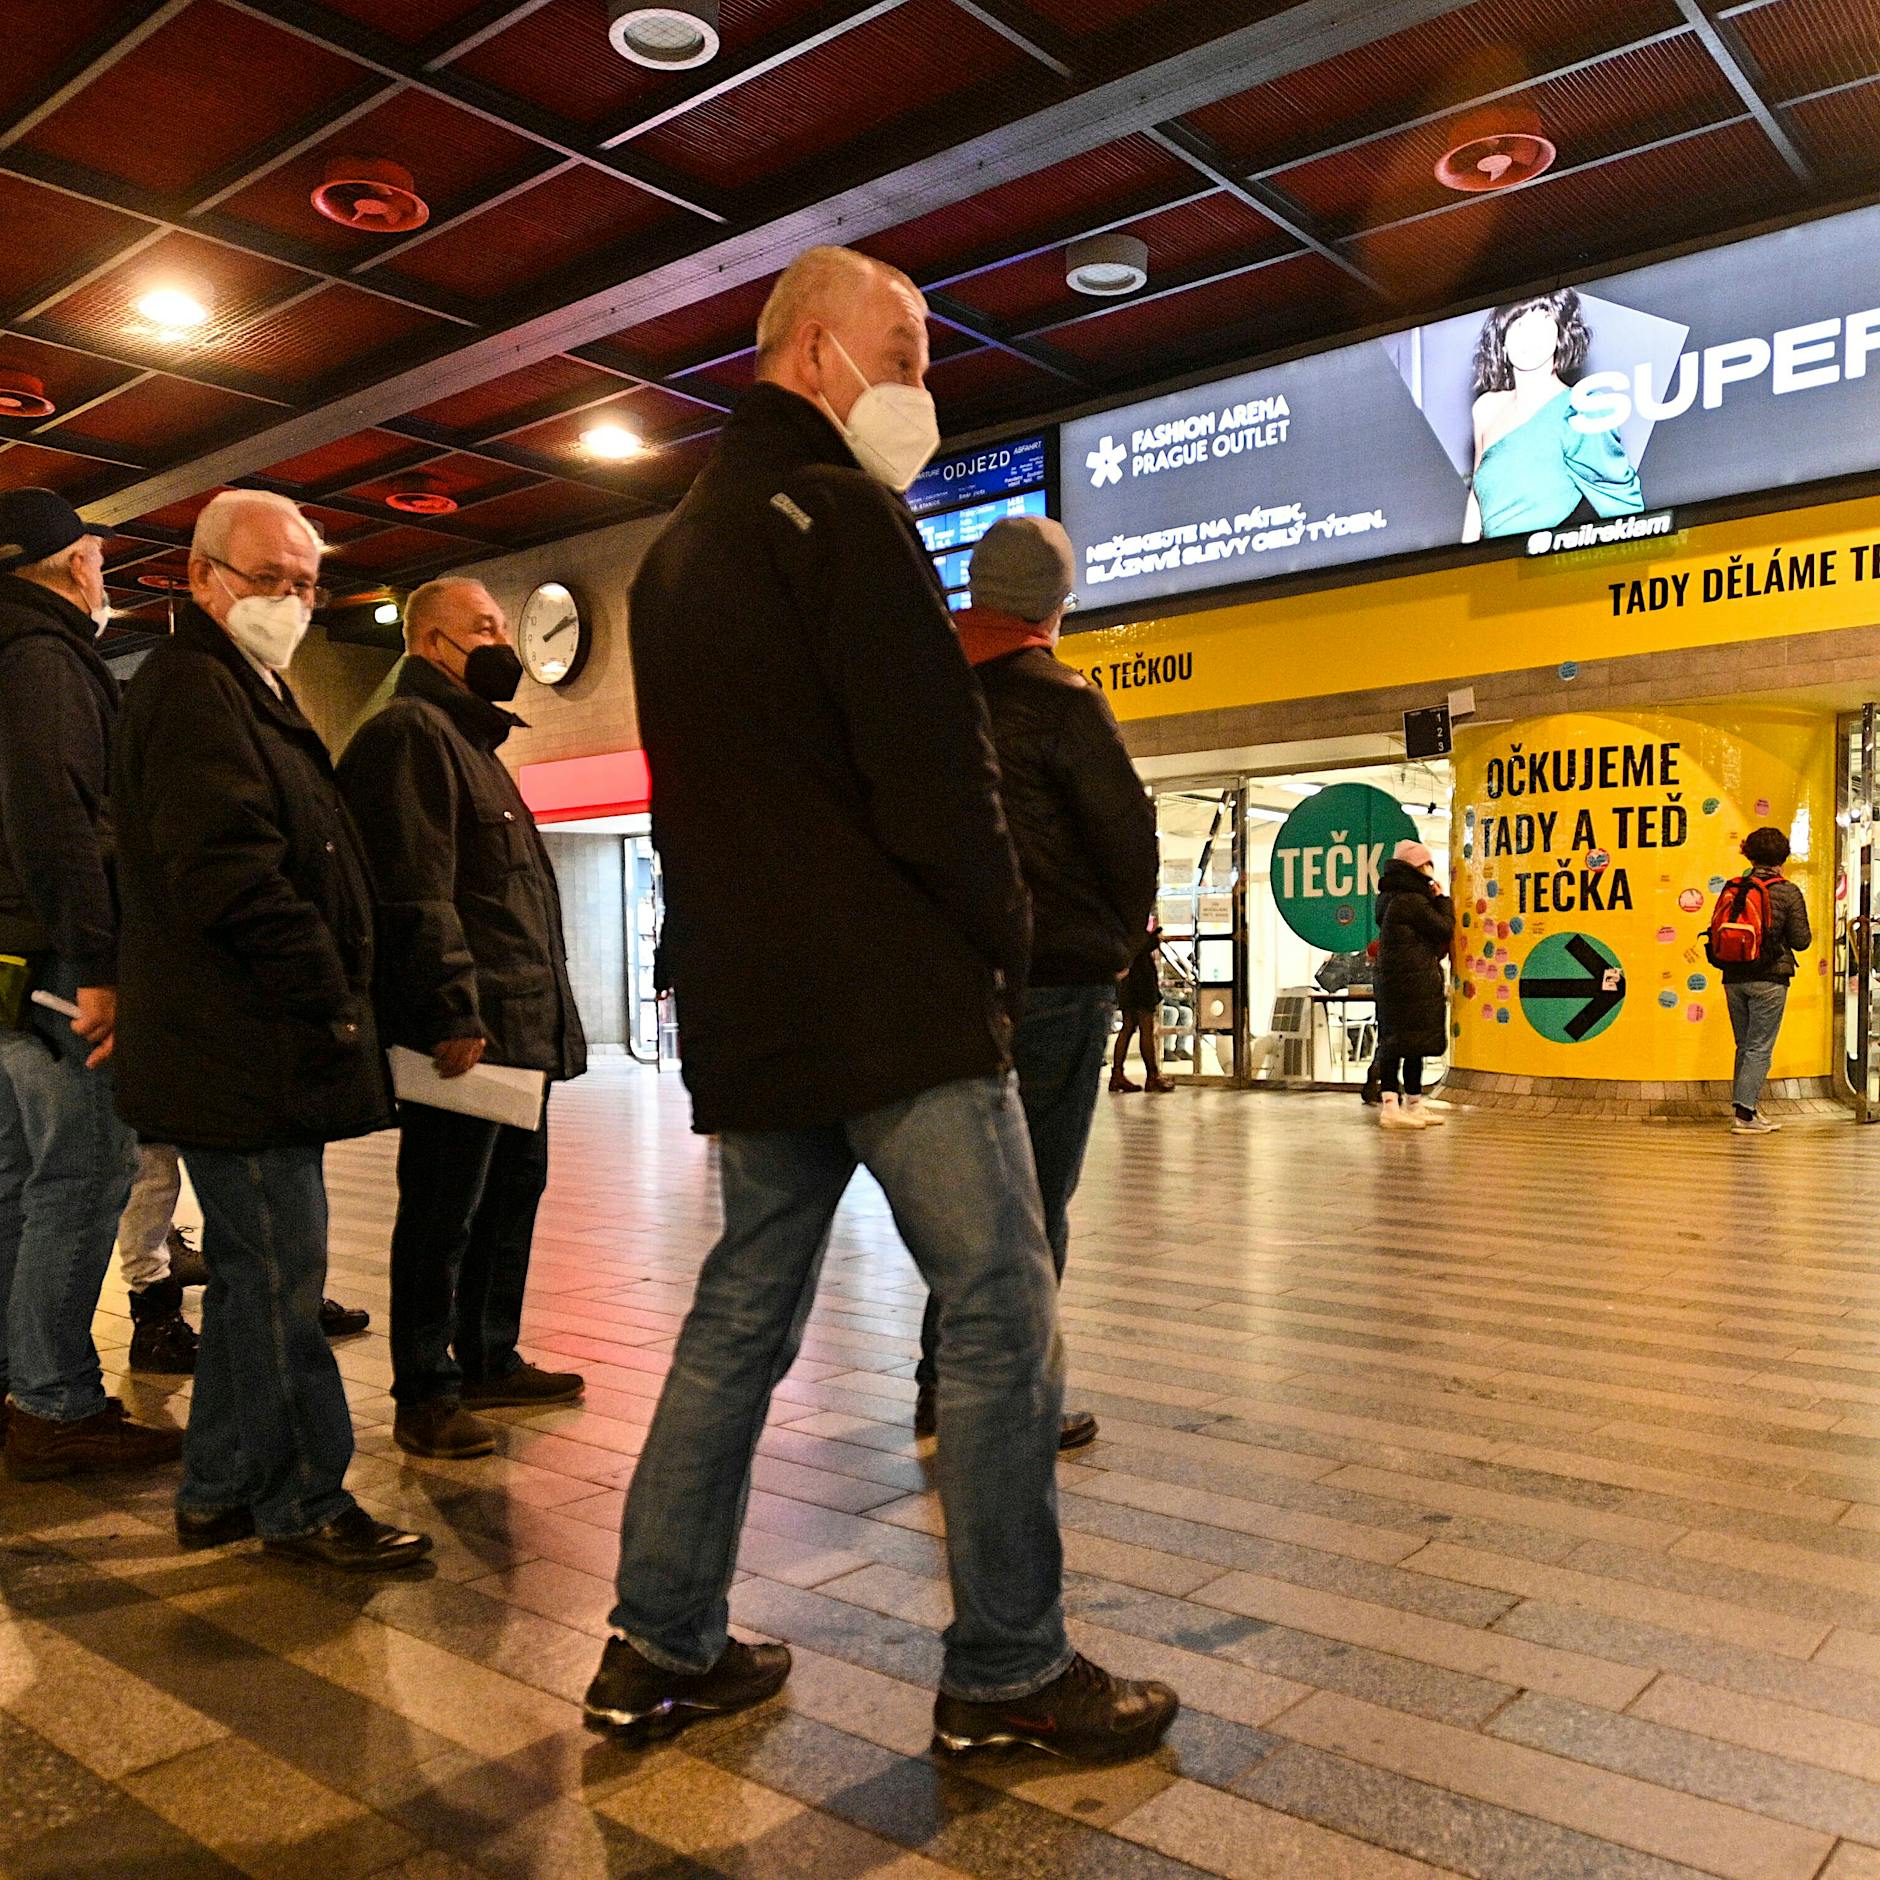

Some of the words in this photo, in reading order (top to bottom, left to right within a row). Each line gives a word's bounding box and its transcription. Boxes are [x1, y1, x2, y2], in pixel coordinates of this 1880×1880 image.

[1131, 412, 1216, 452] FASHION
[1218, 394, 1290, 432] ARENA
[1132, 439, 1208, 477] PRAGUE
[1212, 420, 1291, 457] OUTLET
[942, 450, 1011, 481] ODJEZD
[1199, 517, 1233, 540] NA
[1608, 572, 1690, 617] TADY
[1702, 548, 1837, 604] DĚLÁME
[1109, 652, 1192, 690] TEČKOU
[1436, 726, 1443, 737] 2
[1438, 742, 1444, 751] 3
[1487, 742, 1680, 799] OČKUJEME
[1481, 811, 1558, 858] TADY
[1571, 809, 1596, 851] A
[1612, 793, 1688, 849] TEĎ
[1277, 829, 1398, 899] TEČK
[1514, 858, 1633, 914] TEČKA
